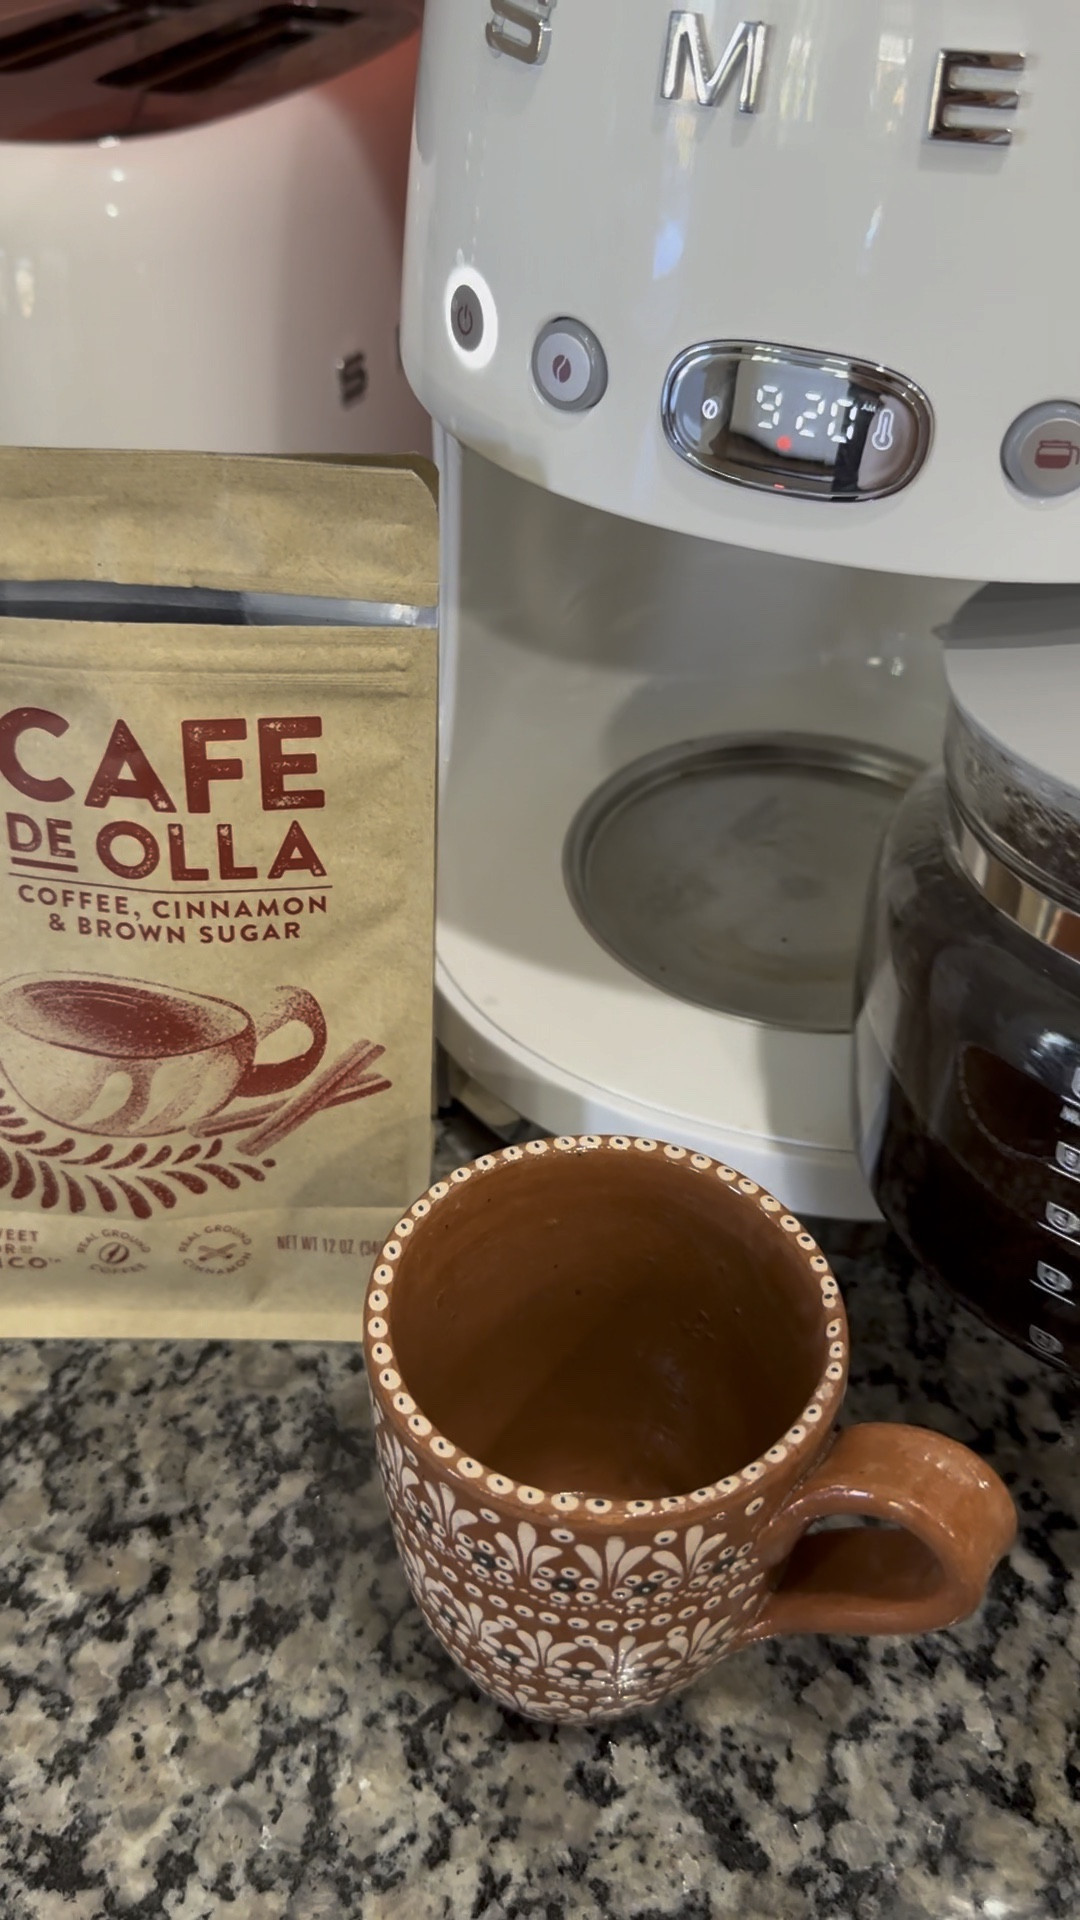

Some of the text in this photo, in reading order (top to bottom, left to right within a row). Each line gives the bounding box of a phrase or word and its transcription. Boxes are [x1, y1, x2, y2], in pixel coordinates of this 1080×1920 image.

[0, 707, 326, 814] CAFE
[6, 812, 327, 881] DE OLLA
[18, 884, 327, 921] COFFEE, CINNAMON
[48, 913, 300, 944] & BROWN SUGAR
[0, 1228, 38, 1242] EET
[277, 1235, 297, 1250] NET
[301, 1236, 318, 1251] WT
[322, 1238, 336, 1253] 12
